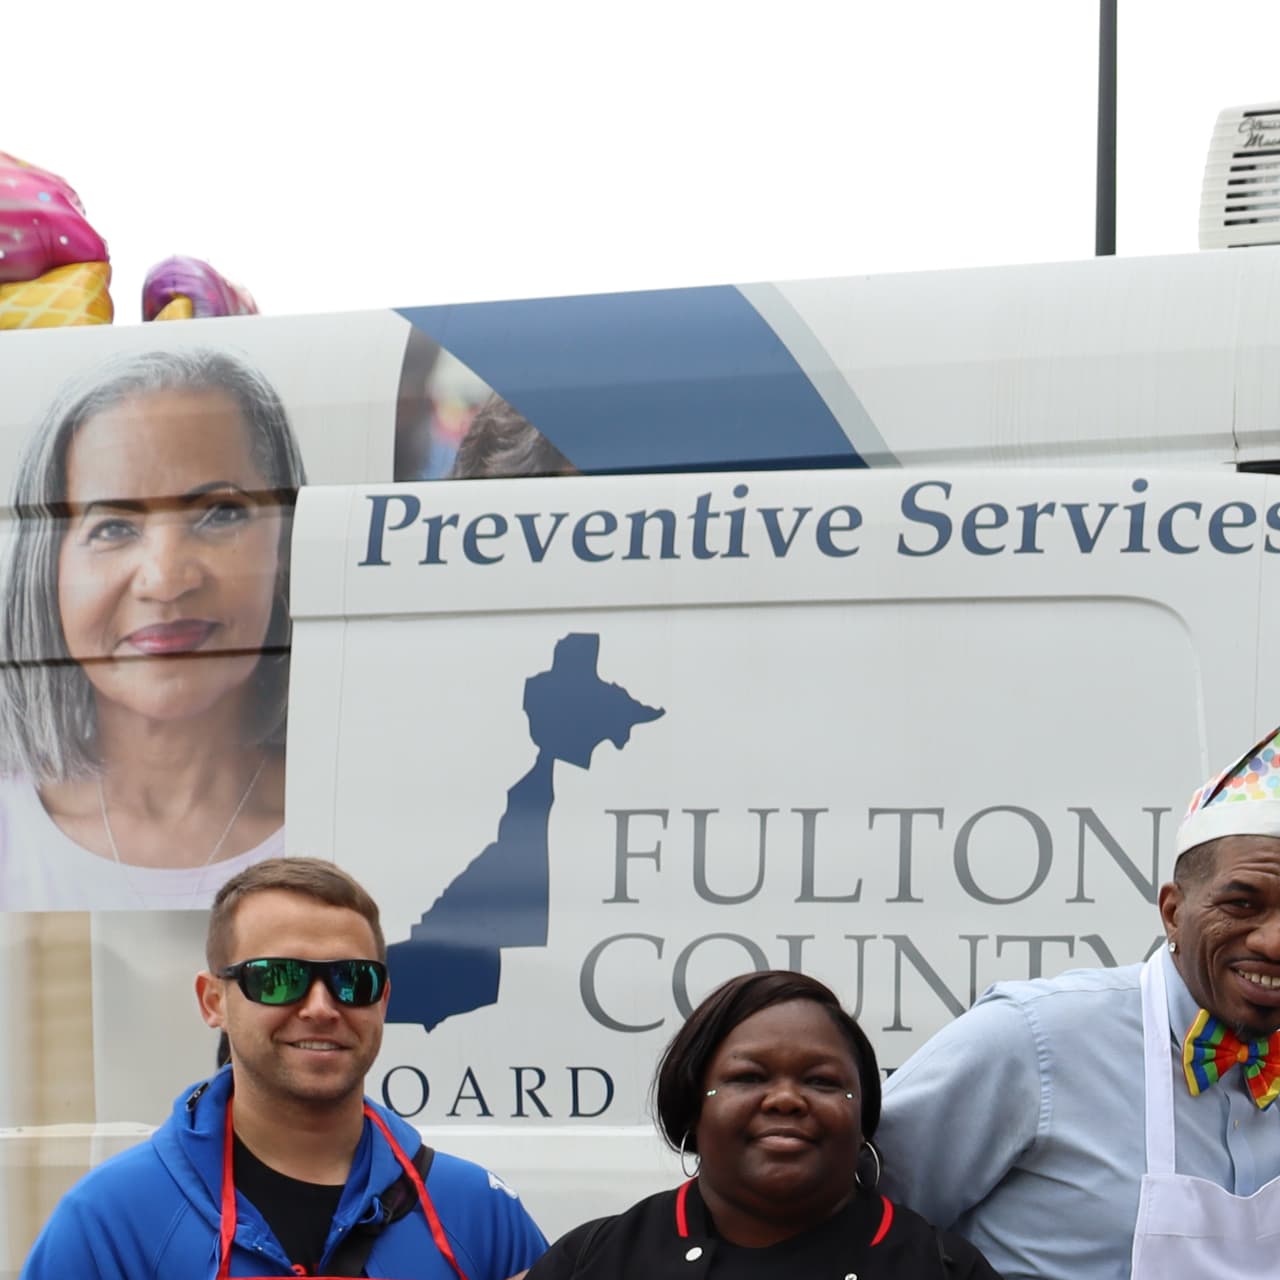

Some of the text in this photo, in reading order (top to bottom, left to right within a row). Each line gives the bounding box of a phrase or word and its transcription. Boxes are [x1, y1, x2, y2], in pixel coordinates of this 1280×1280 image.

[358, 483, 864, 567] Preventive
[602, 805, 1173, 906] FULTON
[381, 1065, 615, 1119] OARD
